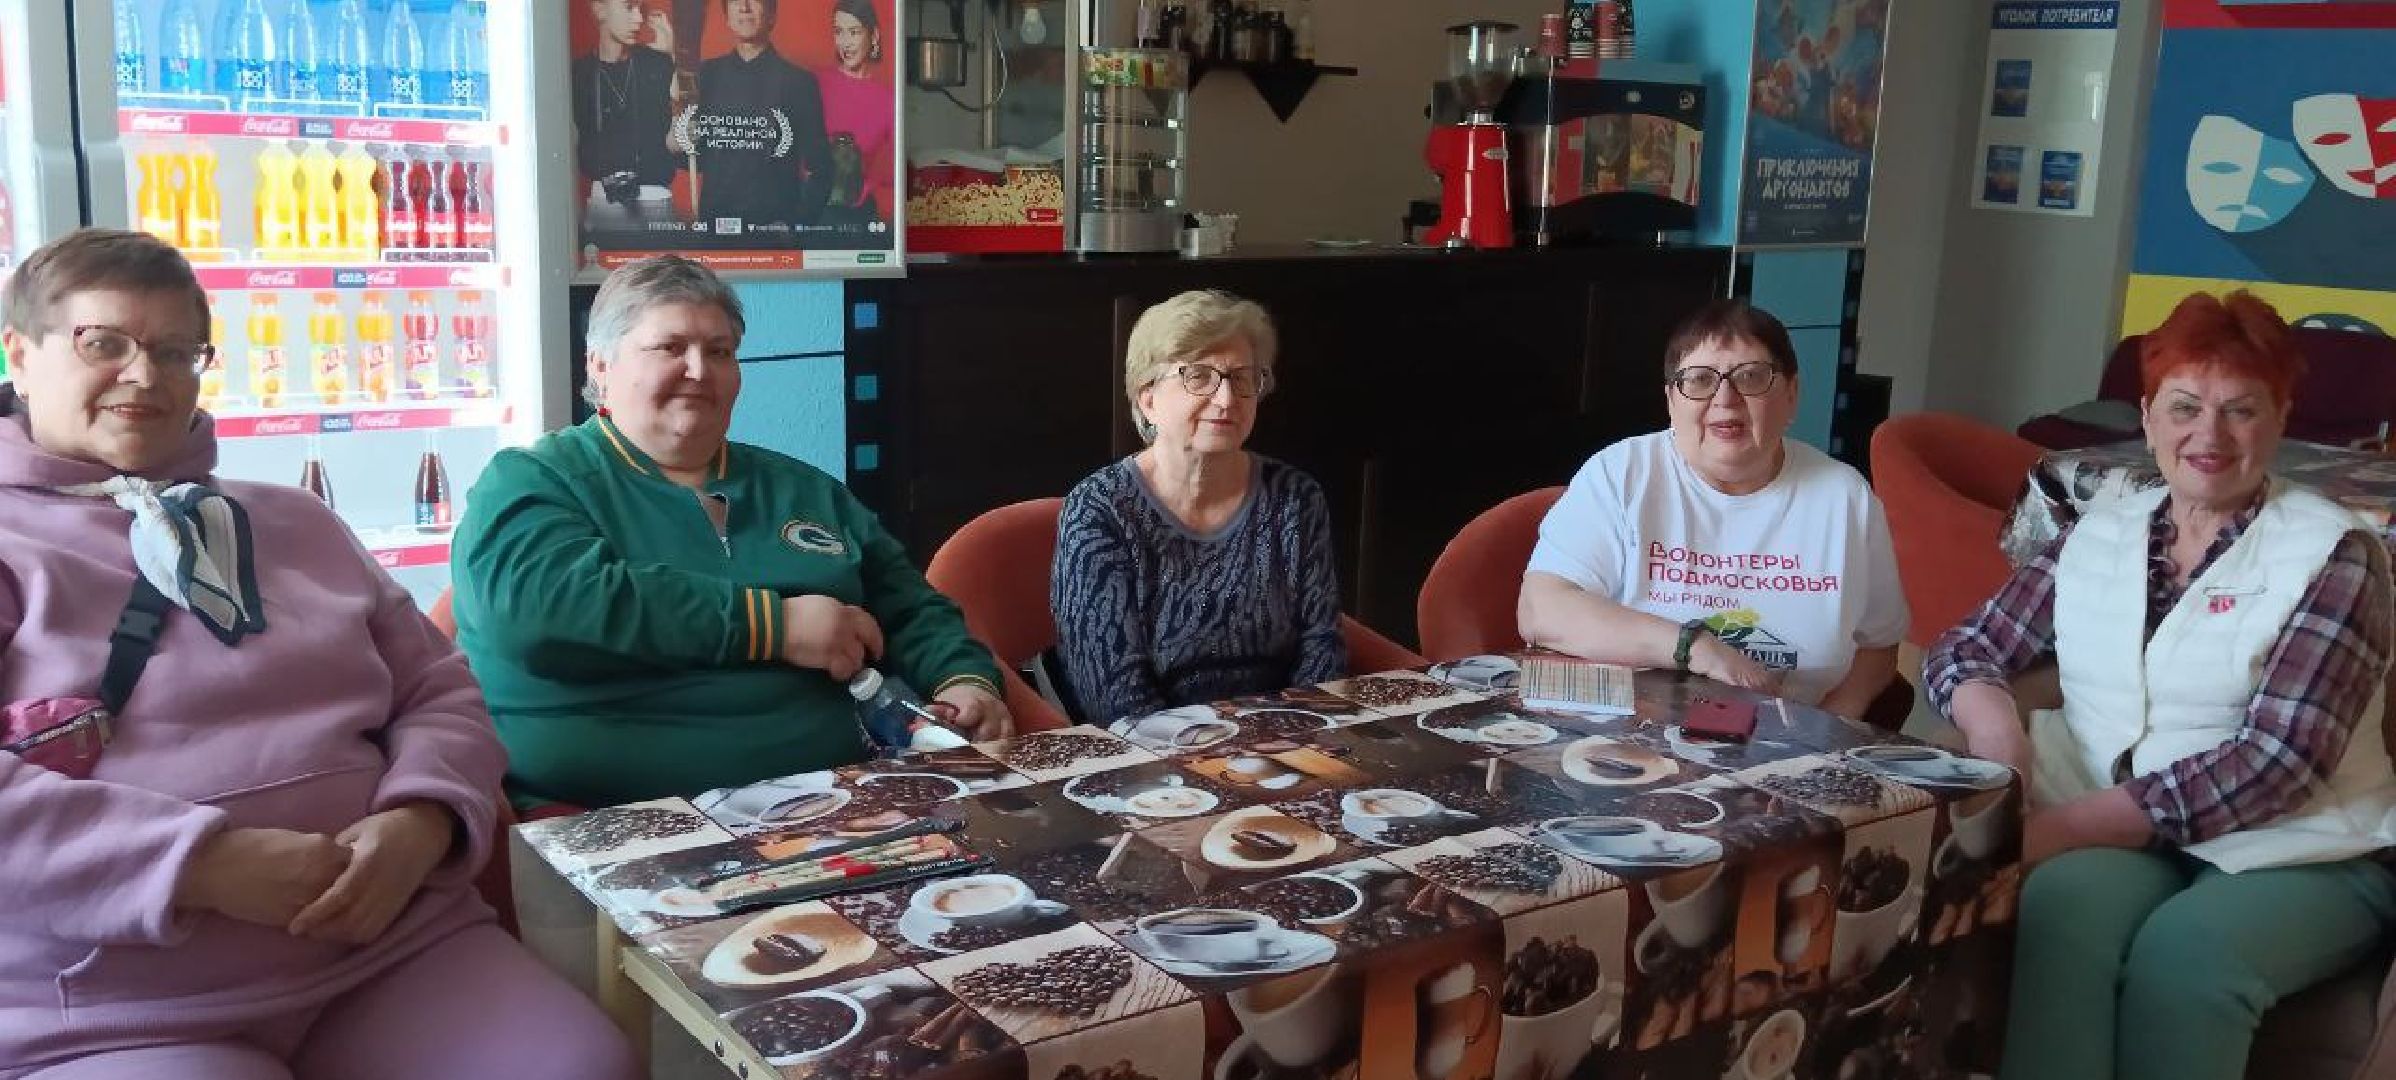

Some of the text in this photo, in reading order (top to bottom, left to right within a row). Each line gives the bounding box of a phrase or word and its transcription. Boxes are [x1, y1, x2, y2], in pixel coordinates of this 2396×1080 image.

[2041, 8, 2115, 23] ПОТРЕБИТЕЛЯ
[699, 115, 768, 127] ОСНОВАНО
[712, 127, 777, 139] РЕАЛЬНОЙ
[706, 139, 764, 150] ИСТОРИИ
[1681, 592, 1741, 610] РЯДОМ
